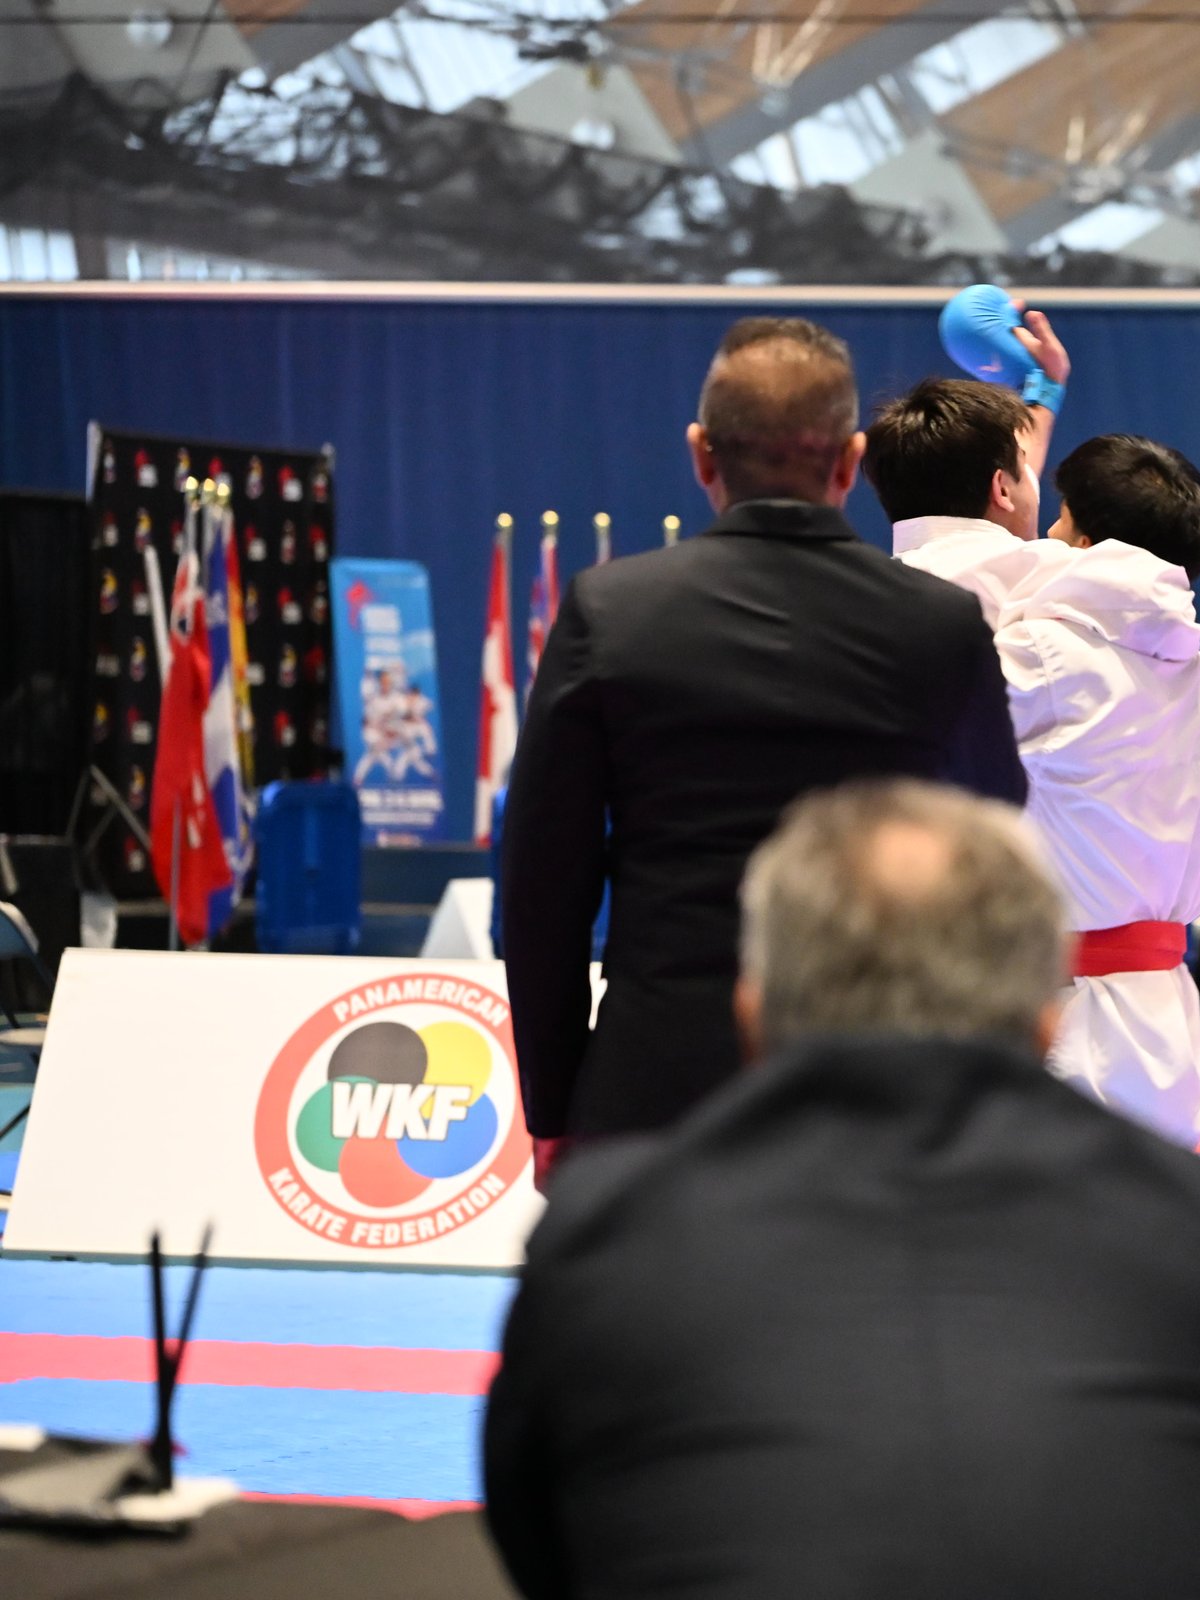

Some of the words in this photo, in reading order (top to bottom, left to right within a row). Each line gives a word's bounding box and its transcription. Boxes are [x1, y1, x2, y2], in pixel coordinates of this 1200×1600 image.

[332, 978, 509, 1026] PANAMERICAN
[331, 1081, 472, 1141] WKF
[269, 1167, 348, 1239] KARATE
[350, 1173, 506, 1246] FEDERATION
